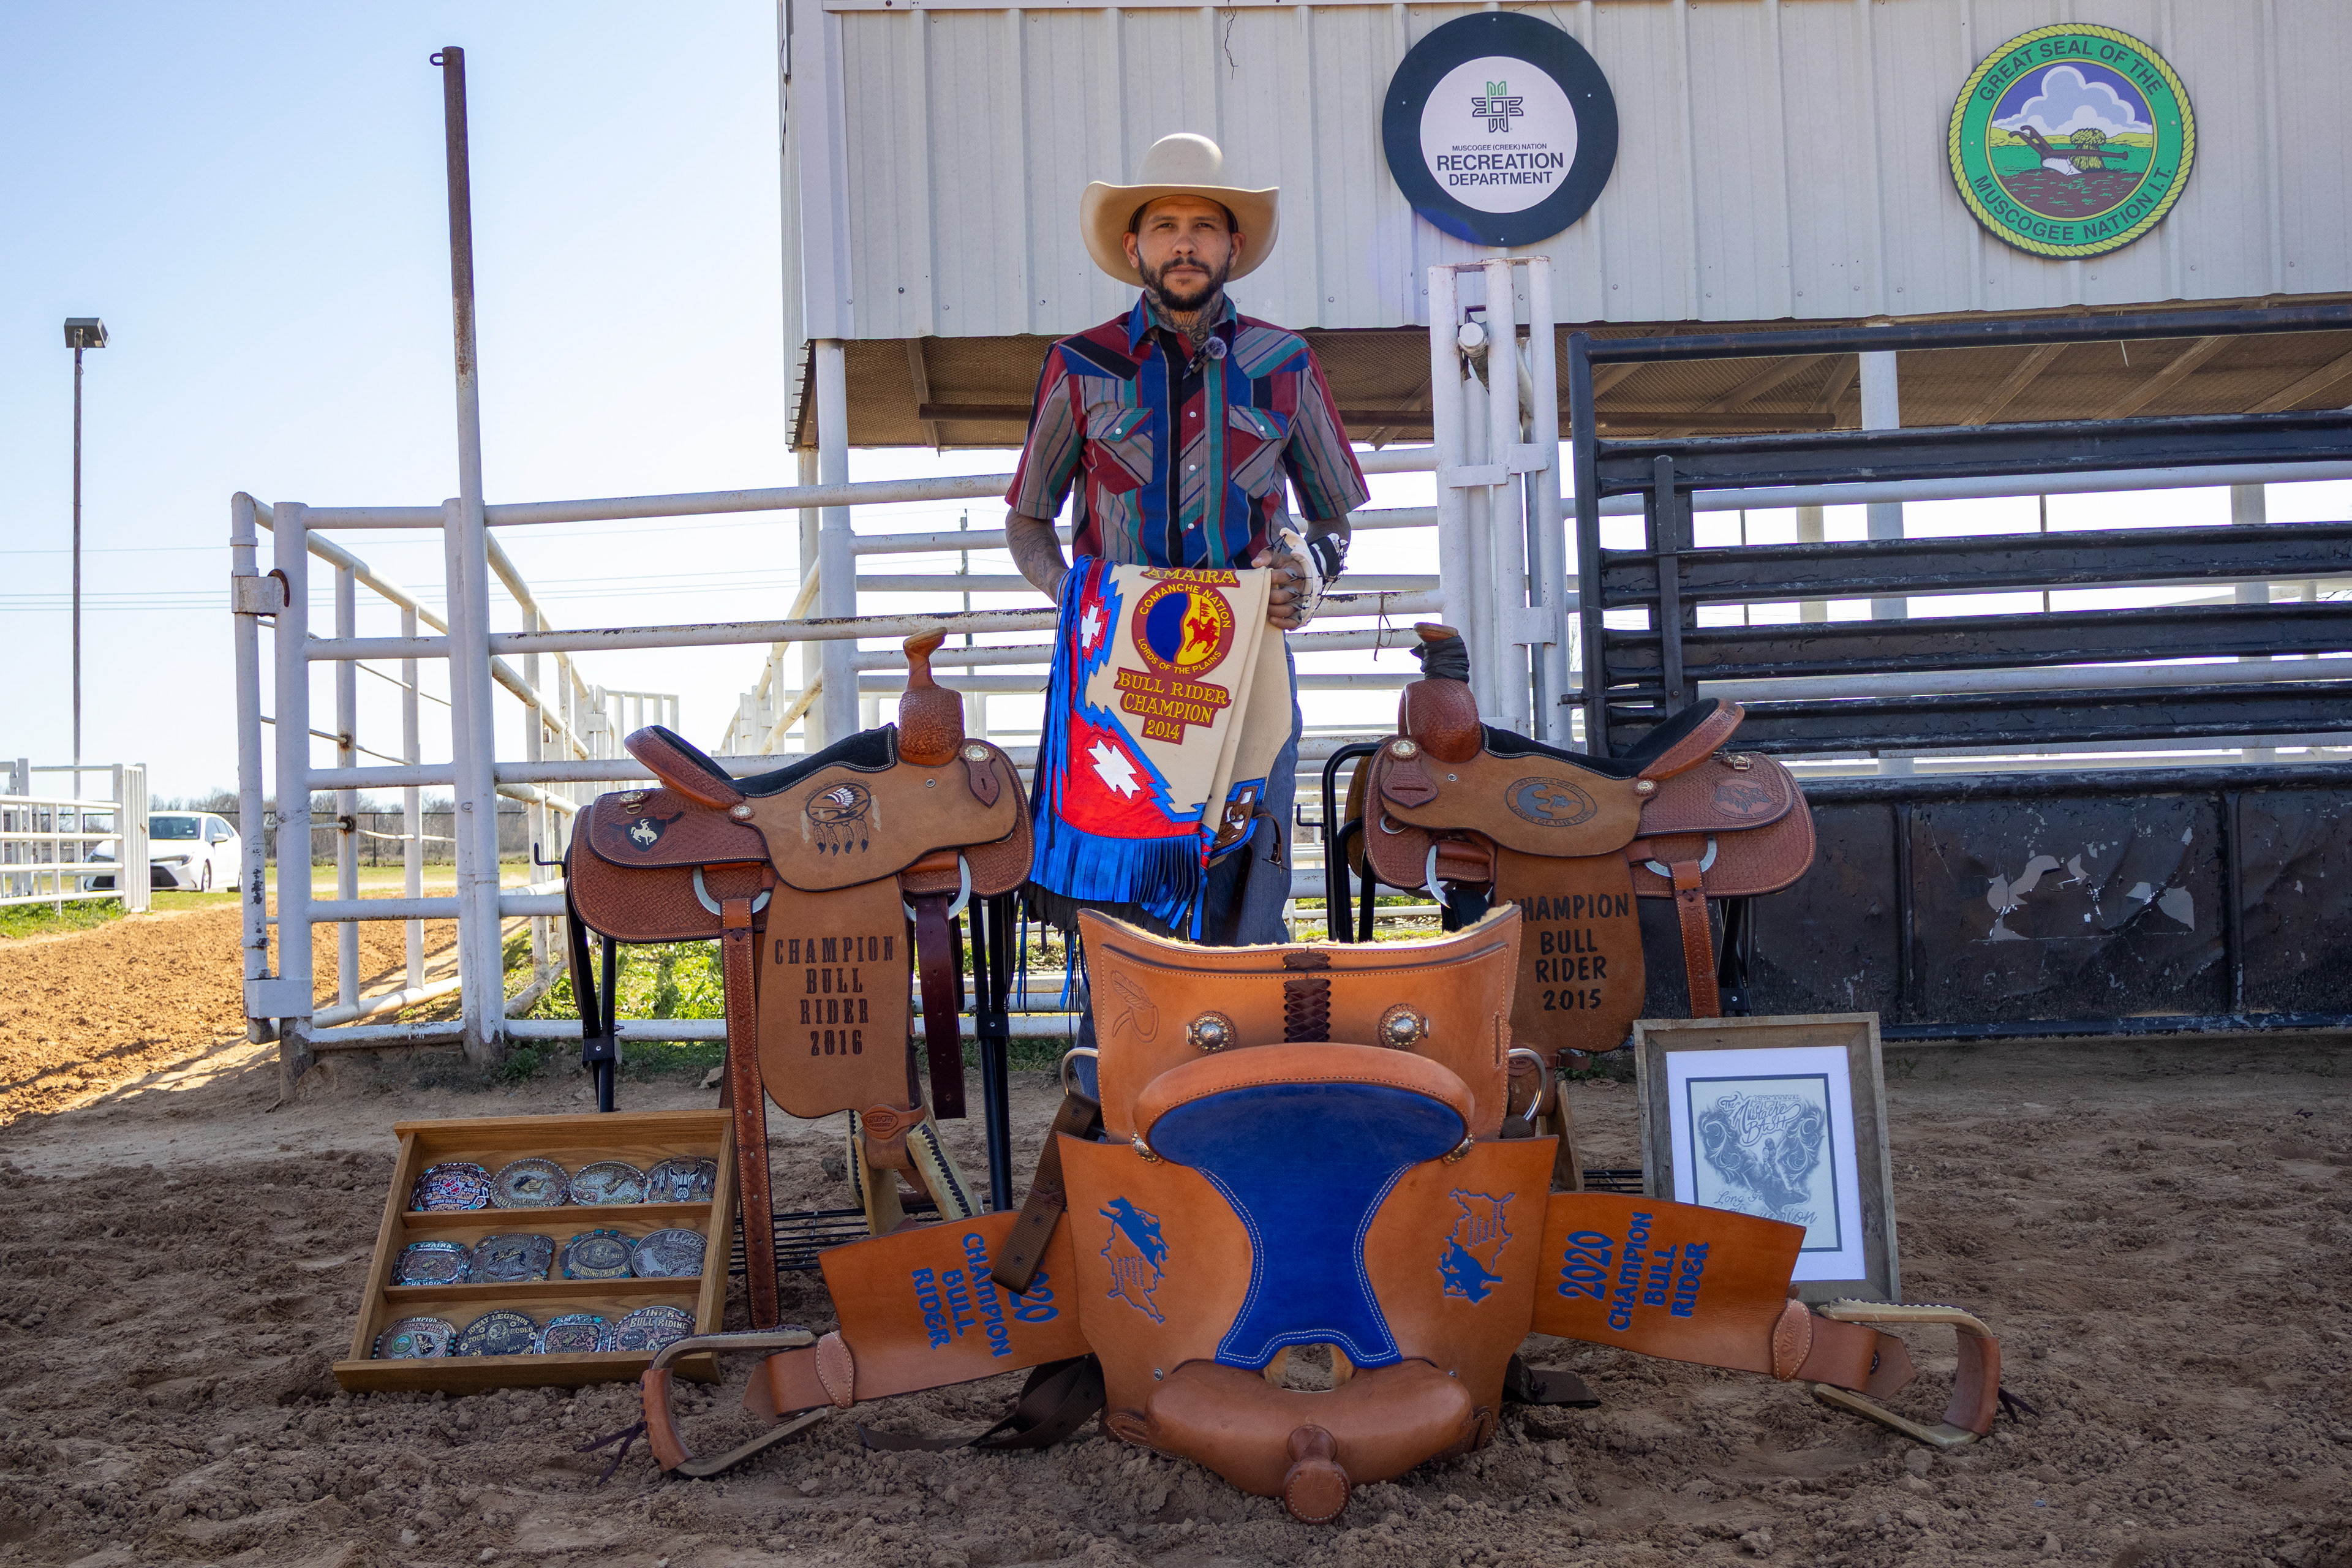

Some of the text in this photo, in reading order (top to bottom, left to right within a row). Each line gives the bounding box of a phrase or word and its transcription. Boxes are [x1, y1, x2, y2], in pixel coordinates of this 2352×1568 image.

[1979, 40, 2163, 100] GREAT SEAL OF THE
[1437, 153, 1564, 171] RECREATION
[1449, 172, 1553, 186] DEPARTMENT
[1974, 167, 2172, 241] MUSCOGEE NATION I.T.
[1145, 568, 1237, 584] AMAIRA
[1140, 584, 1231, 628] COMANCHE NATION
[1138, 638, 1158, 665] LORDS
[1159, 662, 1170, 671] OF
[1192, 651, 1221, 673] PLAINS
[1118, 673, 1227, 704] BULL RIDER
[1123, 693, 1213, 724] CHAMPION
[1146, 720, 1180, 740] 2014
[834, 777, 872, 789] OKLAHOMA
[1510, 778, 1554, 793] COMANCHE
[1511, 805, 1534, 822] LORDS
[1520, 892, 1629, 922] HAMPION
[775, 936, 893, 965] CHAMPION
[1540, 928, 1598, 956] BULL
[806, 968, 863, 994] BULL
[1536, 956, 1607, 983] RIDER
[800, 998, 869, 1025] RIDER
[1542, 989, 1602, 1011] 2015
[810, 1029, 862, 1056] 2016
[1718, 1095, 1799, 1134] The Mustache
[1742, 1116, 1787, 1144] BASH
[513, 1162, 554, 1175] ACRA
[1714, 1191, 1745, 1207] Long
[570, 1262, 627, 1278] BULL RIDING CHAMPION
[1558, 1231, 1615, 1301] 2020
[1608, 1212, 1654, 1331] CHAMPION
[1643, 1244, 1678, 1306] BULL
[1670, 1242, 1709, 1317] RIDER
[941, 1268, 976, 1337] BULL
[962, 1232, 1012, 1359] CHAMPION
[1008, 1256, 1059, 1323] 20
[911, 1267, 951, 1350] RIDER
[467, 1313, 529, 1335] IOWAY LEGENDS
[630, 1317, 687, 1329] BULL RIDING
[467, 1333, 486, 1343] TOUR
